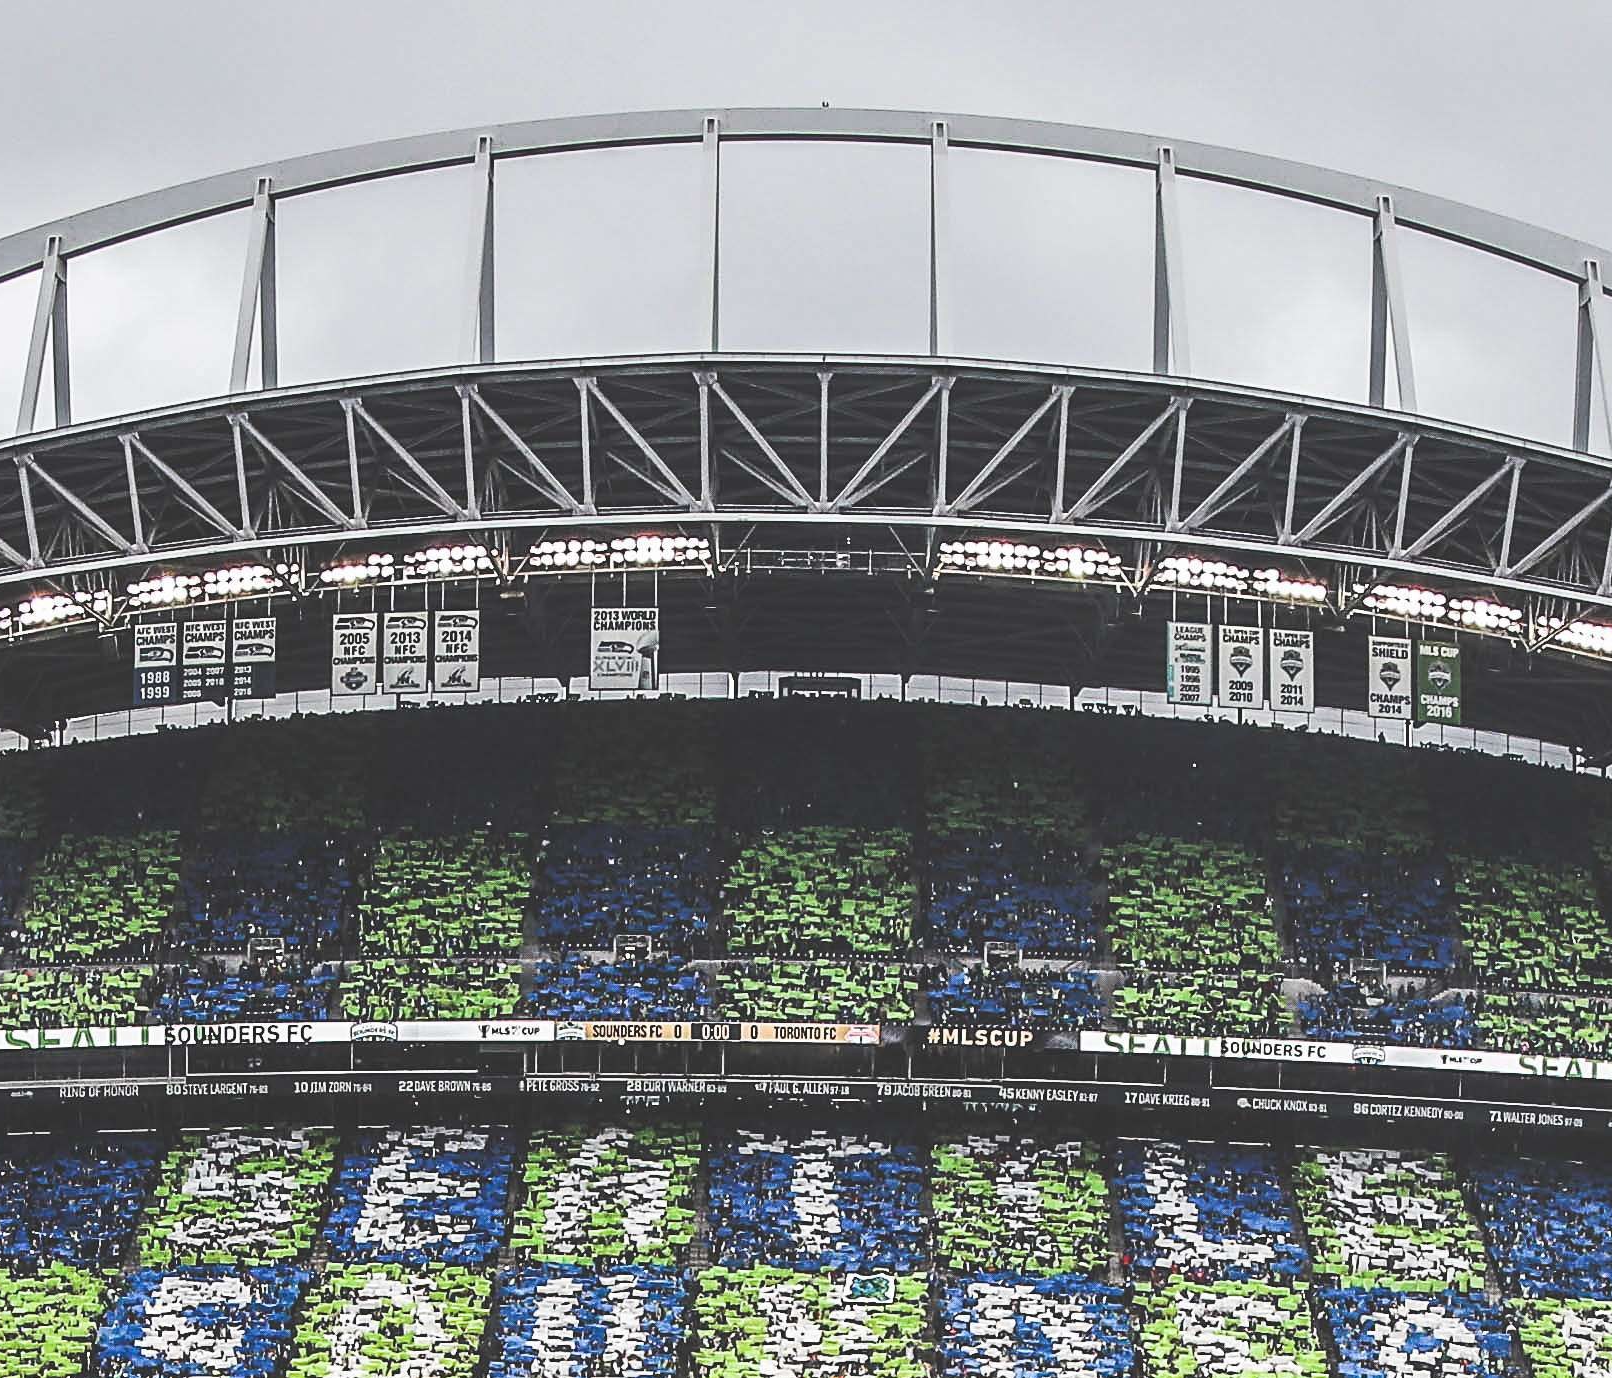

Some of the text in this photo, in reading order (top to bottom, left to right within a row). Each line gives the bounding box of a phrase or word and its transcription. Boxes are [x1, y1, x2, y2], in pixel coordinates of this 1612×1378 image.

[593, 610, 657, 621] 2013 WORLD
[593, 620, 656, 631] CHAMPIONS
[136, 634, 176, 647] CHAMPS
[184, 631, 225, 643] CHAMPS
[234, 628, 275, 641] CHAMPS
[339, 632, 370, 646] 2005
[390, 631, 421, 644] 2013
[441, 630, 472, 644] 2014
[1222, 633, 1260, 646] CHAMPS
[394, 644, 417, 655] NFC
[445, 643, 469, 654] NFC
[1273, 638, 1311, 649] CHAMPS
[343, 645, 366, 656] NFC
[1371, 646, 1409, 660] SHIELD
[140, 670, 170, 685] 1988
[1228, 680, 1254, 691] 2009
[1280, 683, 1303, 695] 2011
[140, 685, 170, 700] 1999
[1228, 691, 1253, 703] 2010
[1370, 692, 1411, 705] CHAMPS
[1280, 694, 1304, 706] 2014
[1378, 704, 1402, 714] 2014
[1426, 705, 1453, 718] 2016
[164, 1024, 313, 1045] SOUNDERS FC
[521, 1027, 540, 1036] CUP
[592, 1025, 837, 1040] SOUNDERS FC 0 0:00 0 TORONTO FC
[927, 1029, 1033, 1047] #MLSCUP
[1221, 1039, 1326, 1058] SOUNDERS FC
[59, 1084, 139, 1098] RING OF HONOR
[165, 1082, 248, 1097] 80 STEVE LARGENT
[293, 1080, 353, 1094] 10 JIM ZORN
[398, 1080, 471, 1093] 22 DAVE BROWN
[526, 1079, 580, 1093] PETE GROSS
[626, 1080, 706, 1093] 28 CURT WARNER
[802, 1082, 829, 1095] ALLEN
[876, 1083, 952, 1098] 79 JACOB GREEN
[998, 1087, 1079, 1102] 45 KENNY EASLEY
[1124, 1092, 1190, 1106] 17 DAVE KRIEG
[1252, 1098, 1309, 1113] CHUCK KNOX
[1370, 1104, 1402, 1117] CORTEZ
[1403, 1105, 1443, 1119] KENNEDY
[1489, 1110, 1564, 1126] 71 WALTER JONES
